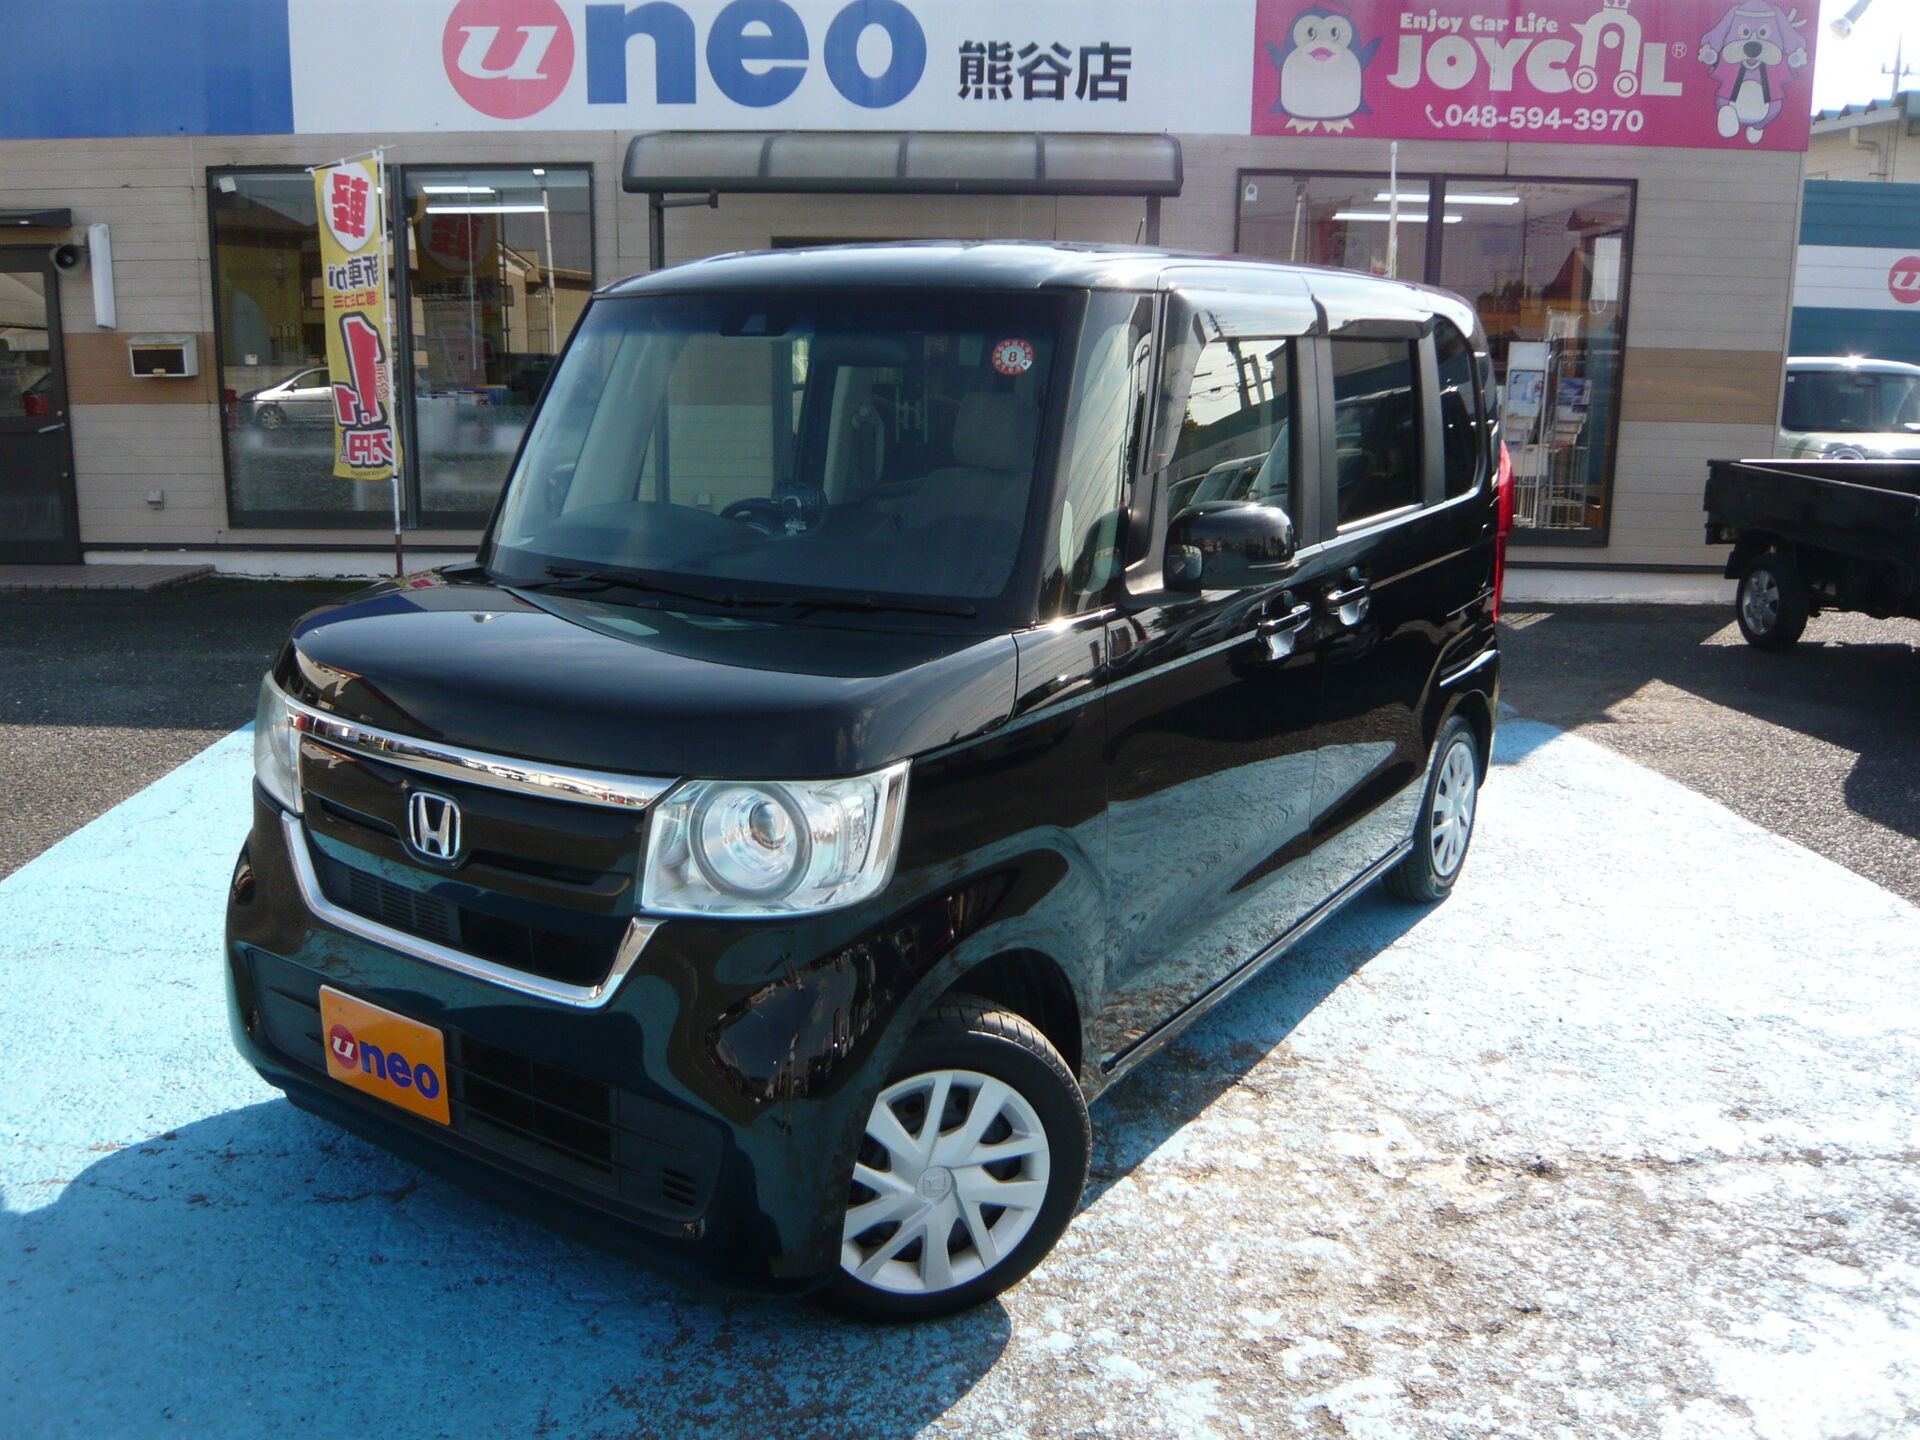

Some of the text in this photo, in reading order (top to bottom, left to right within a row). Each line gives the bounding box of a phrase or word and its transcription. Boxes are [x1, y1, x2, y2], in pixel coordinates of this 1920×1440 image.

[1400, 8, 1559, 34] Enjoy Car Life
[457, 0, 927, 109] uneo
[958, 40, 1132, 102] 熊谷店
[1445, 104, 1644, 132] 048-594-3970
[332, 1035, 440, 1099] uneo
